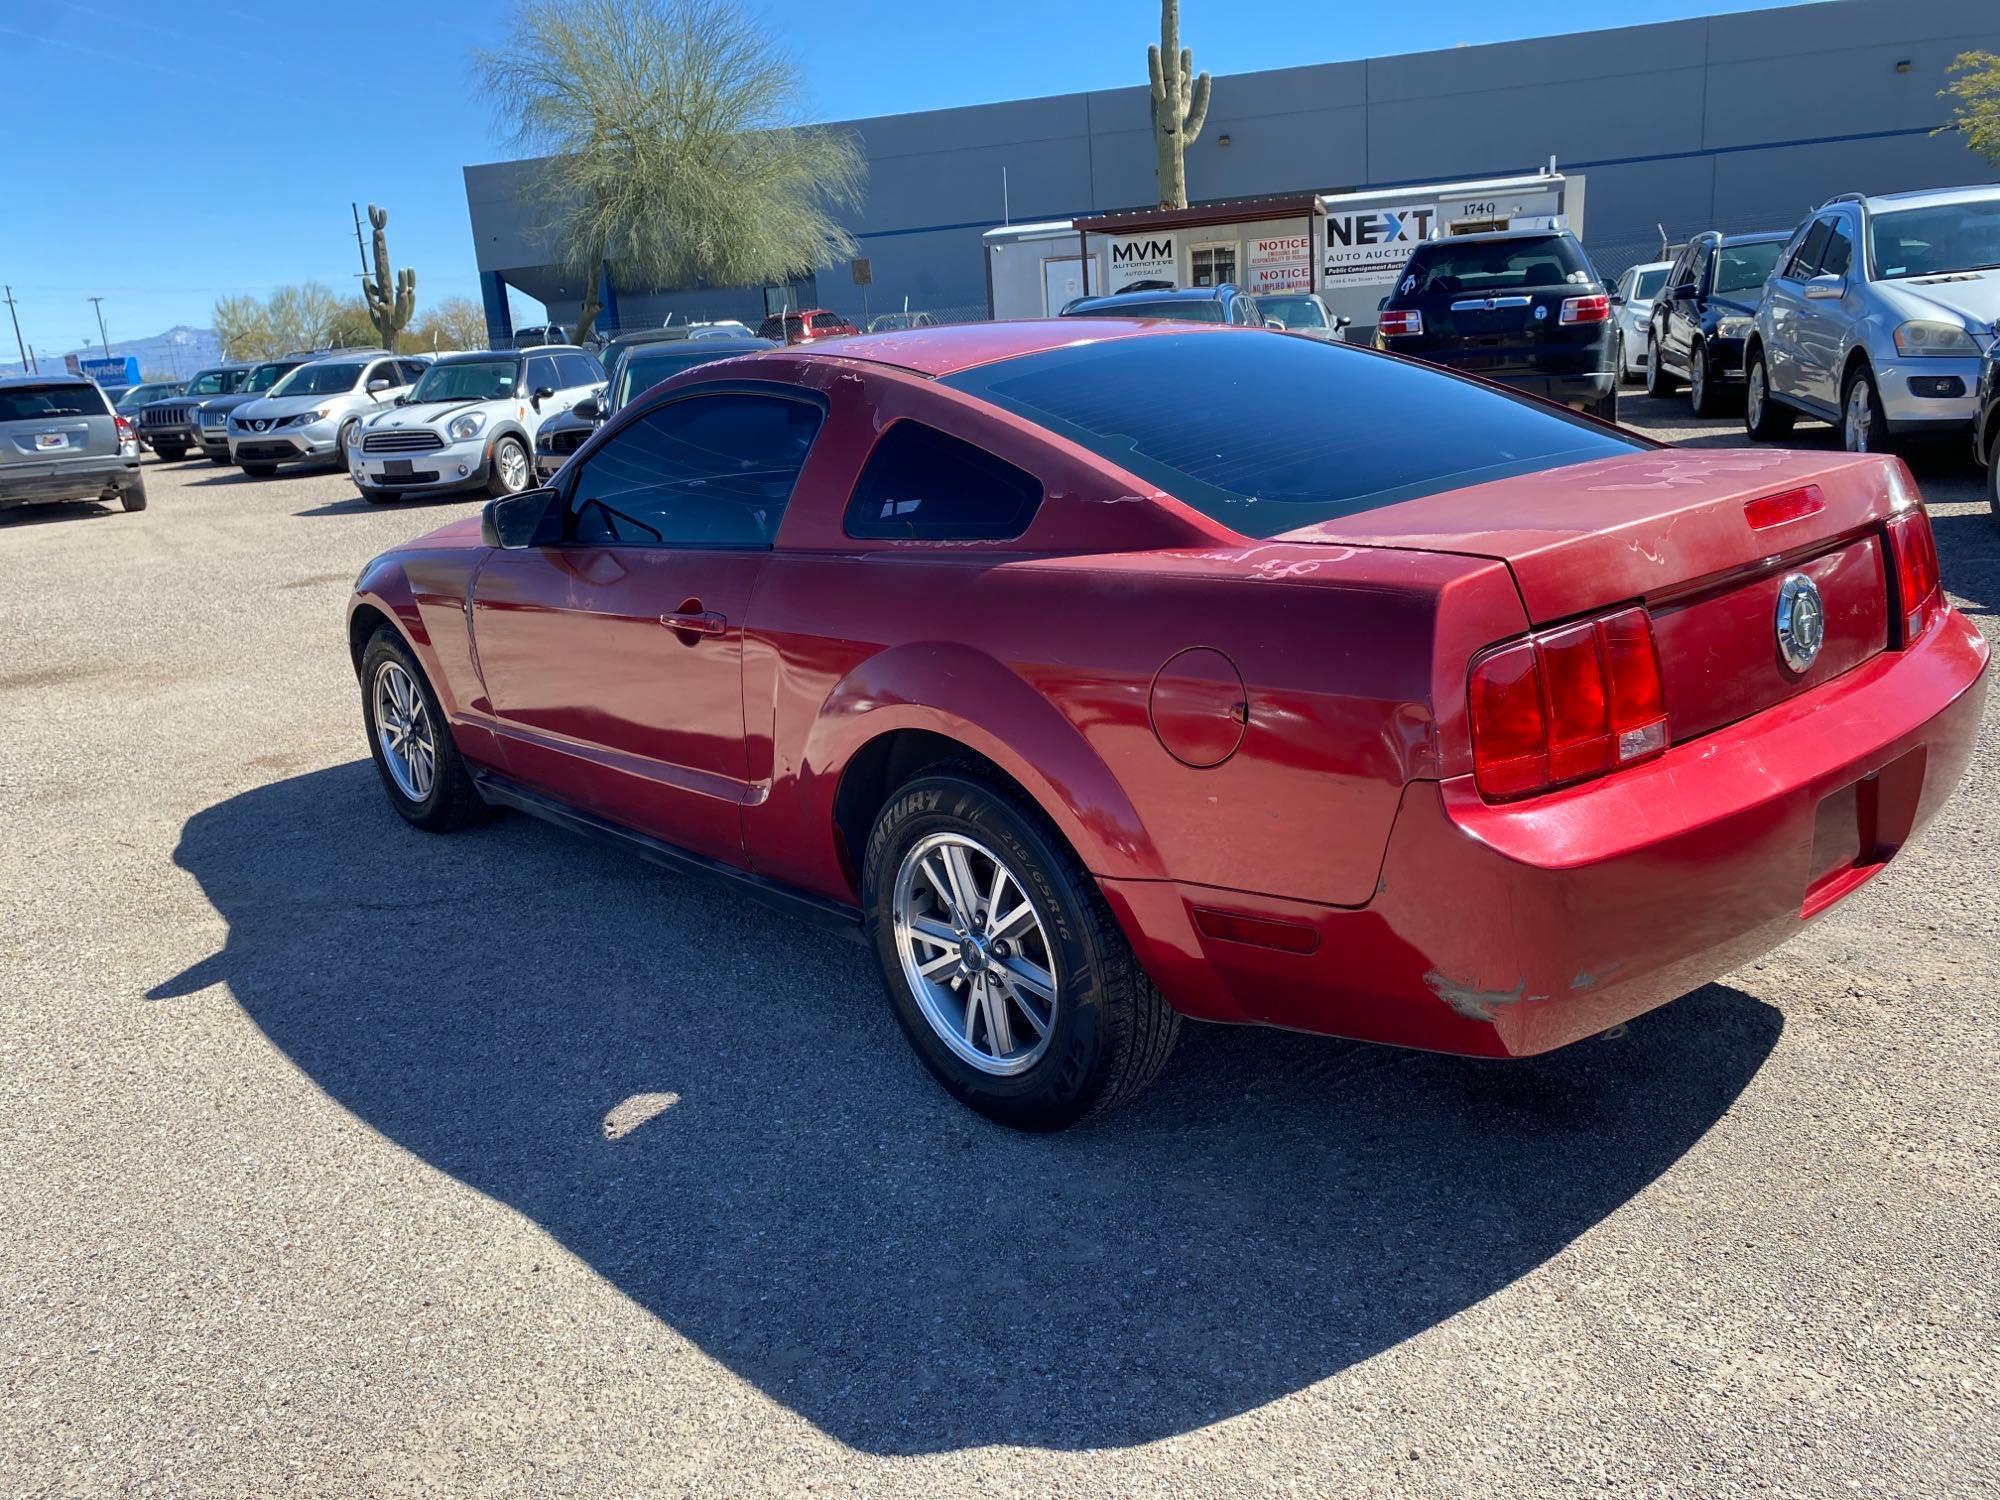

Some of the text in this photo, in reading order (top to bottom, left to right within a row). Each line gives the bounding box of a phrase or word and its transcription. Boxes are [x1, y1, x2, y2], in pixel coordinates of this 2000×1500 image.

[1464, 202, 1495, 215] 1740
[1326, 209, 1434, 248] NEXT
[1112, 239, 1172, 263] MVM
[1258, 238, 1309, 252] NOTICE
[1327, 247, 1416, 263] AUTO AUCTIO
[1260, 267, 1309, 281] NOTICE
[1328, 267, 1347, 275] Public
[1347, 264, 1387, 273] Consignment
[1252, 285, 1260, 293] NO
[1262, 282, 1285, 291] IMPLIED
[1000, 830, 1072, 941] 215/65R16
